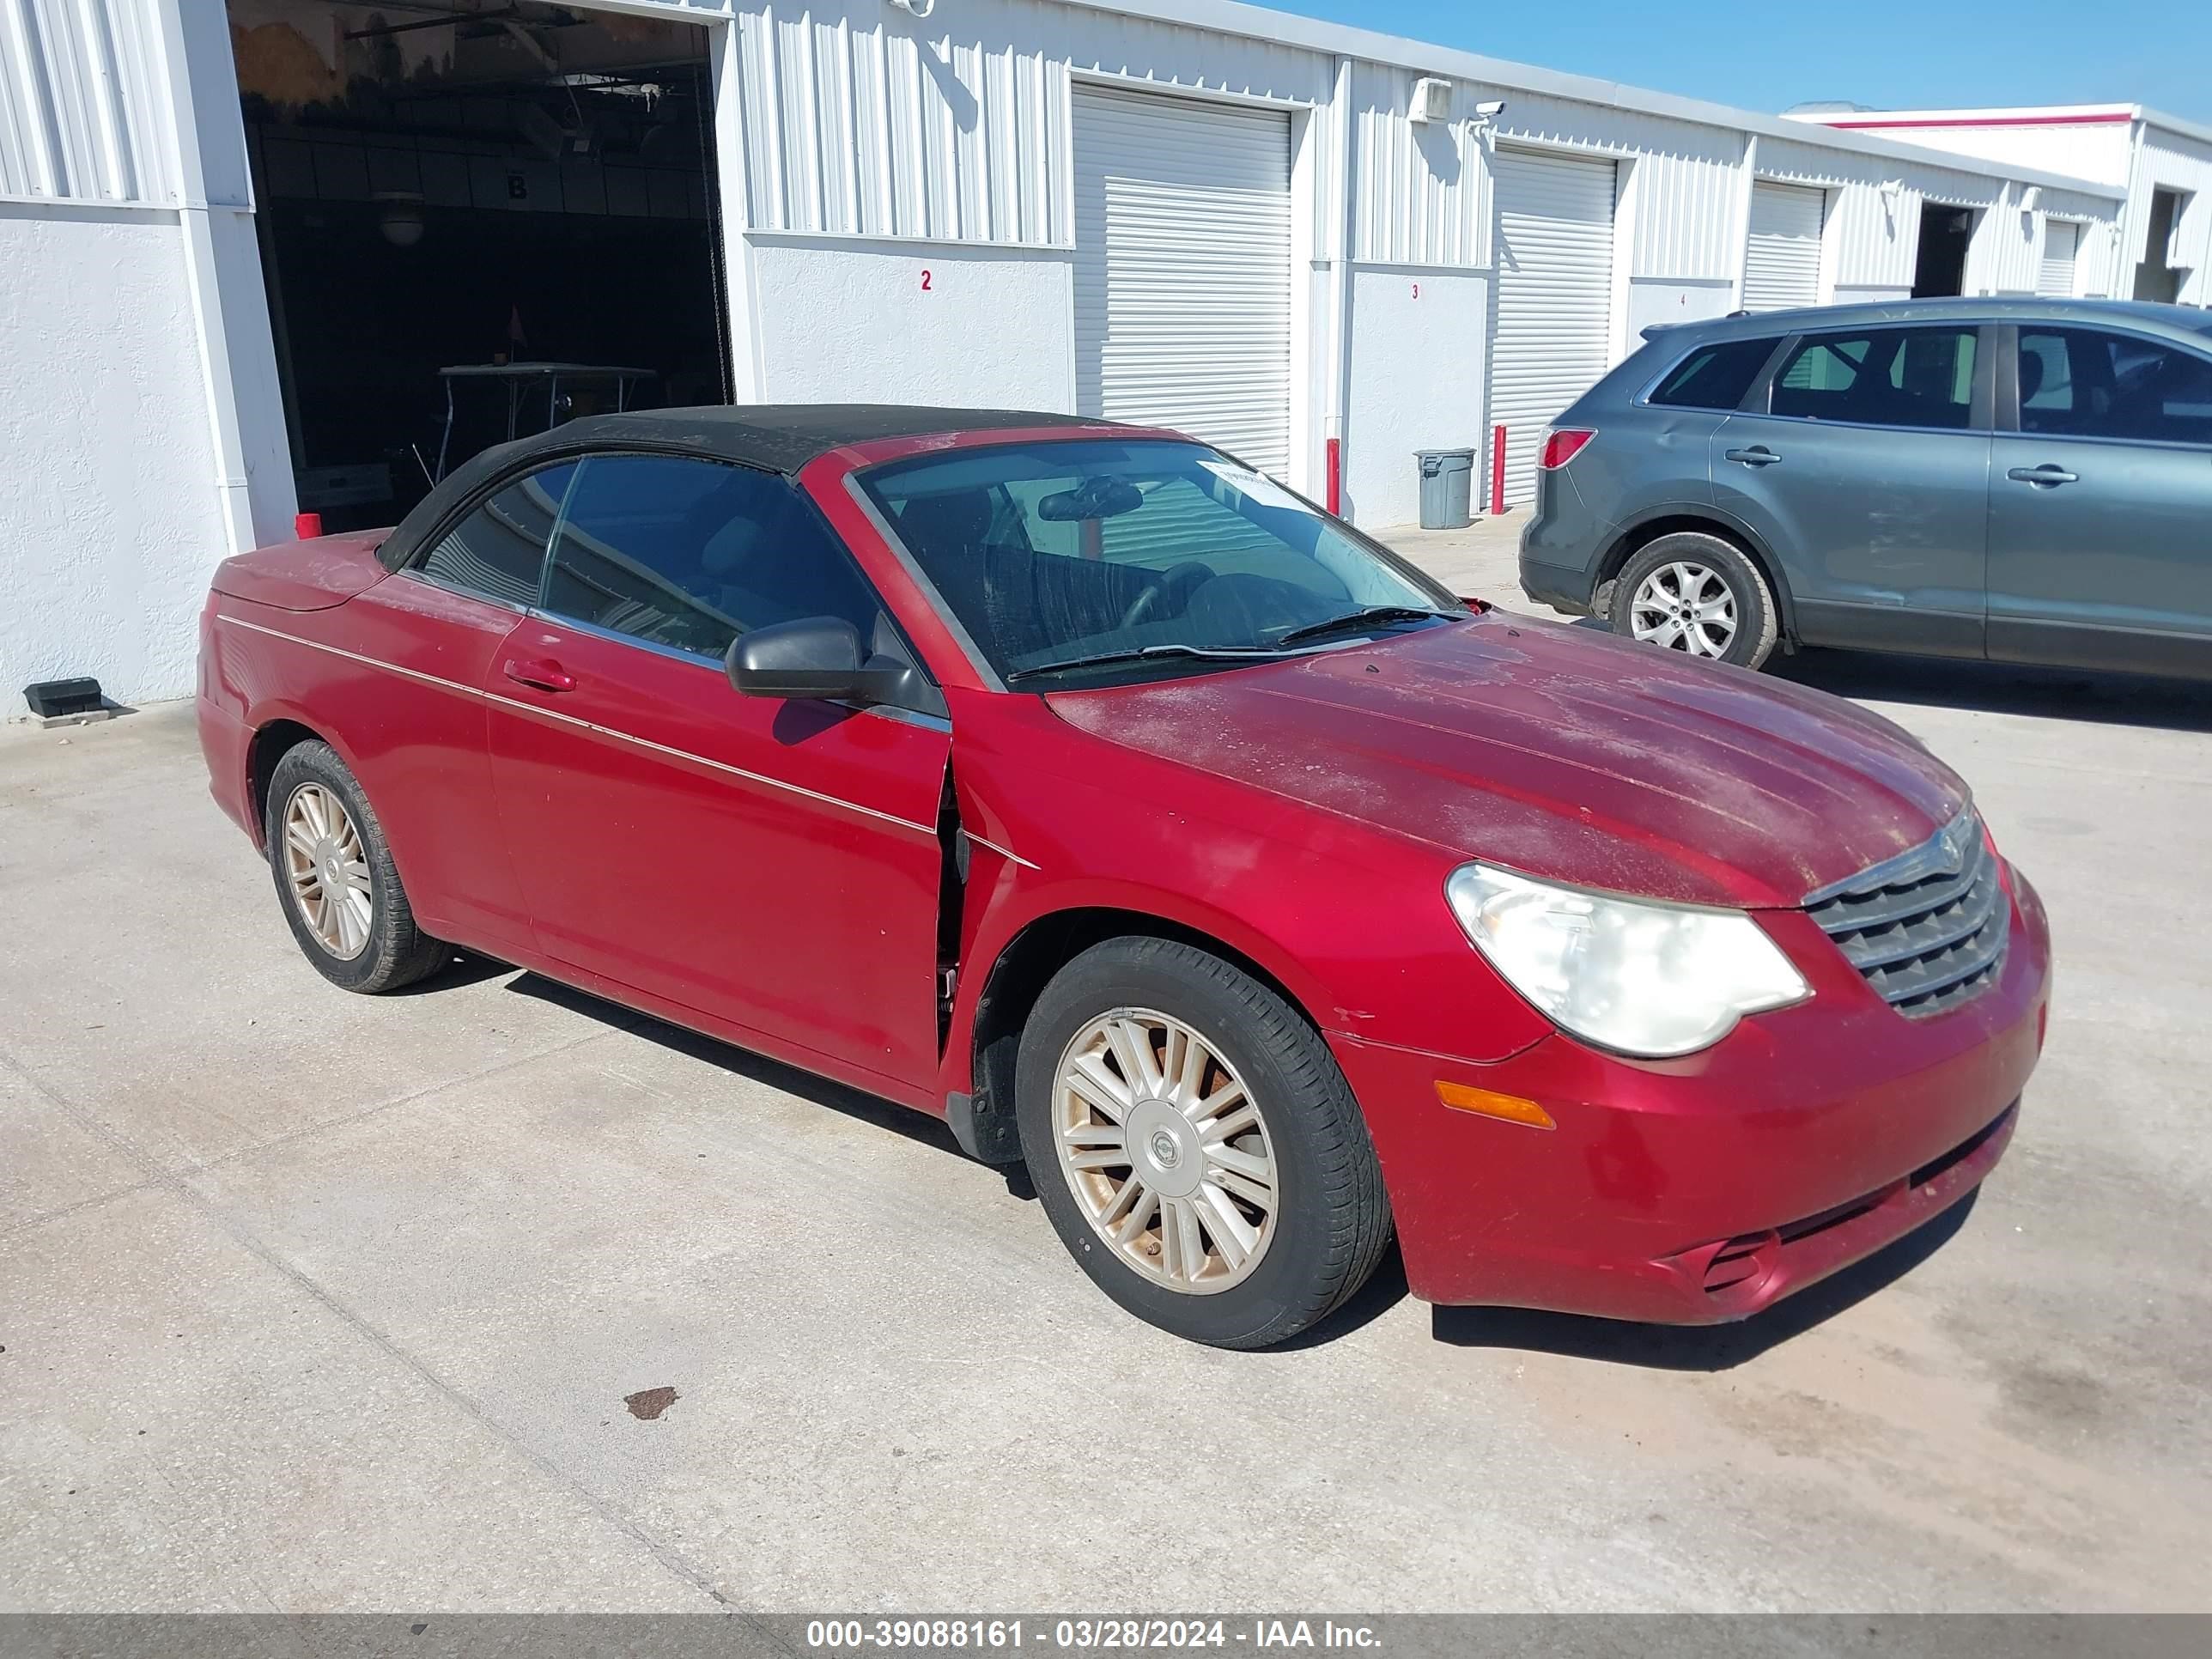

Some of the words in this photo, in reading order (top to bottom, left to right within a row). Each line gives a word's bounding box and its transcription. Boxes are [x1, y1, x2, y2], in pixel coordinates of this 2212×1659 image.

[507, 175, 527, 199] B
[921, 270, 932, 290] 2
[1412, 283, 1419, 300] 3
